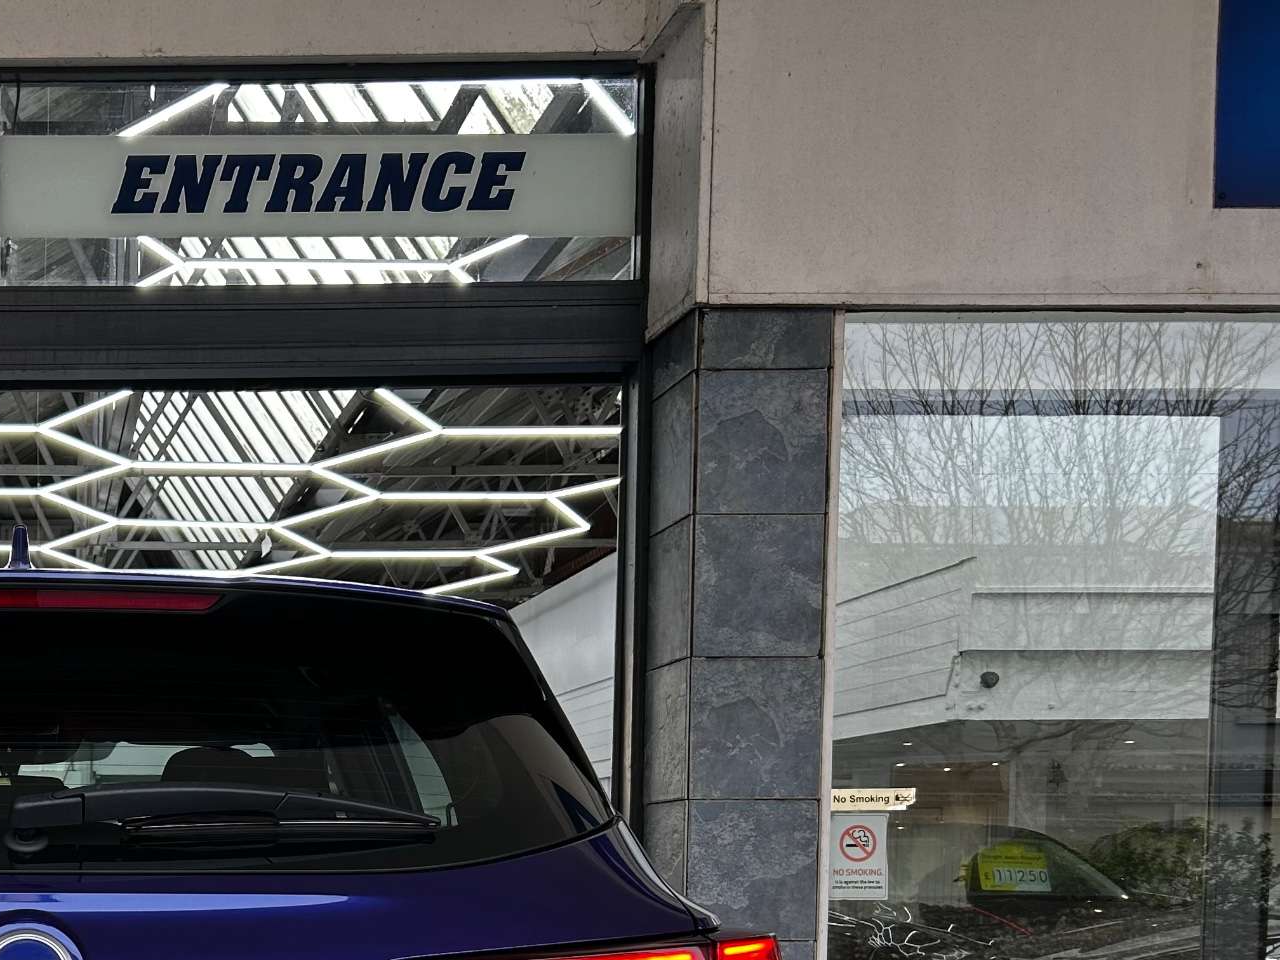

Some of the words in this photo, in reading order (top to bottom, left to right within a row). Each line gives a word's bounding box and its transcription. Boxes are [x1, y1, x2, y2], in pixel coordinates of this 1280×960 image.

[110, 151, 526, 215] ENTRANCE
[833, 795, 847, 804] No
[849, 794, 890, 805] Smoking
[832, 868, 845, 877] NO
[845, 868, 883, 877] SMOKING
